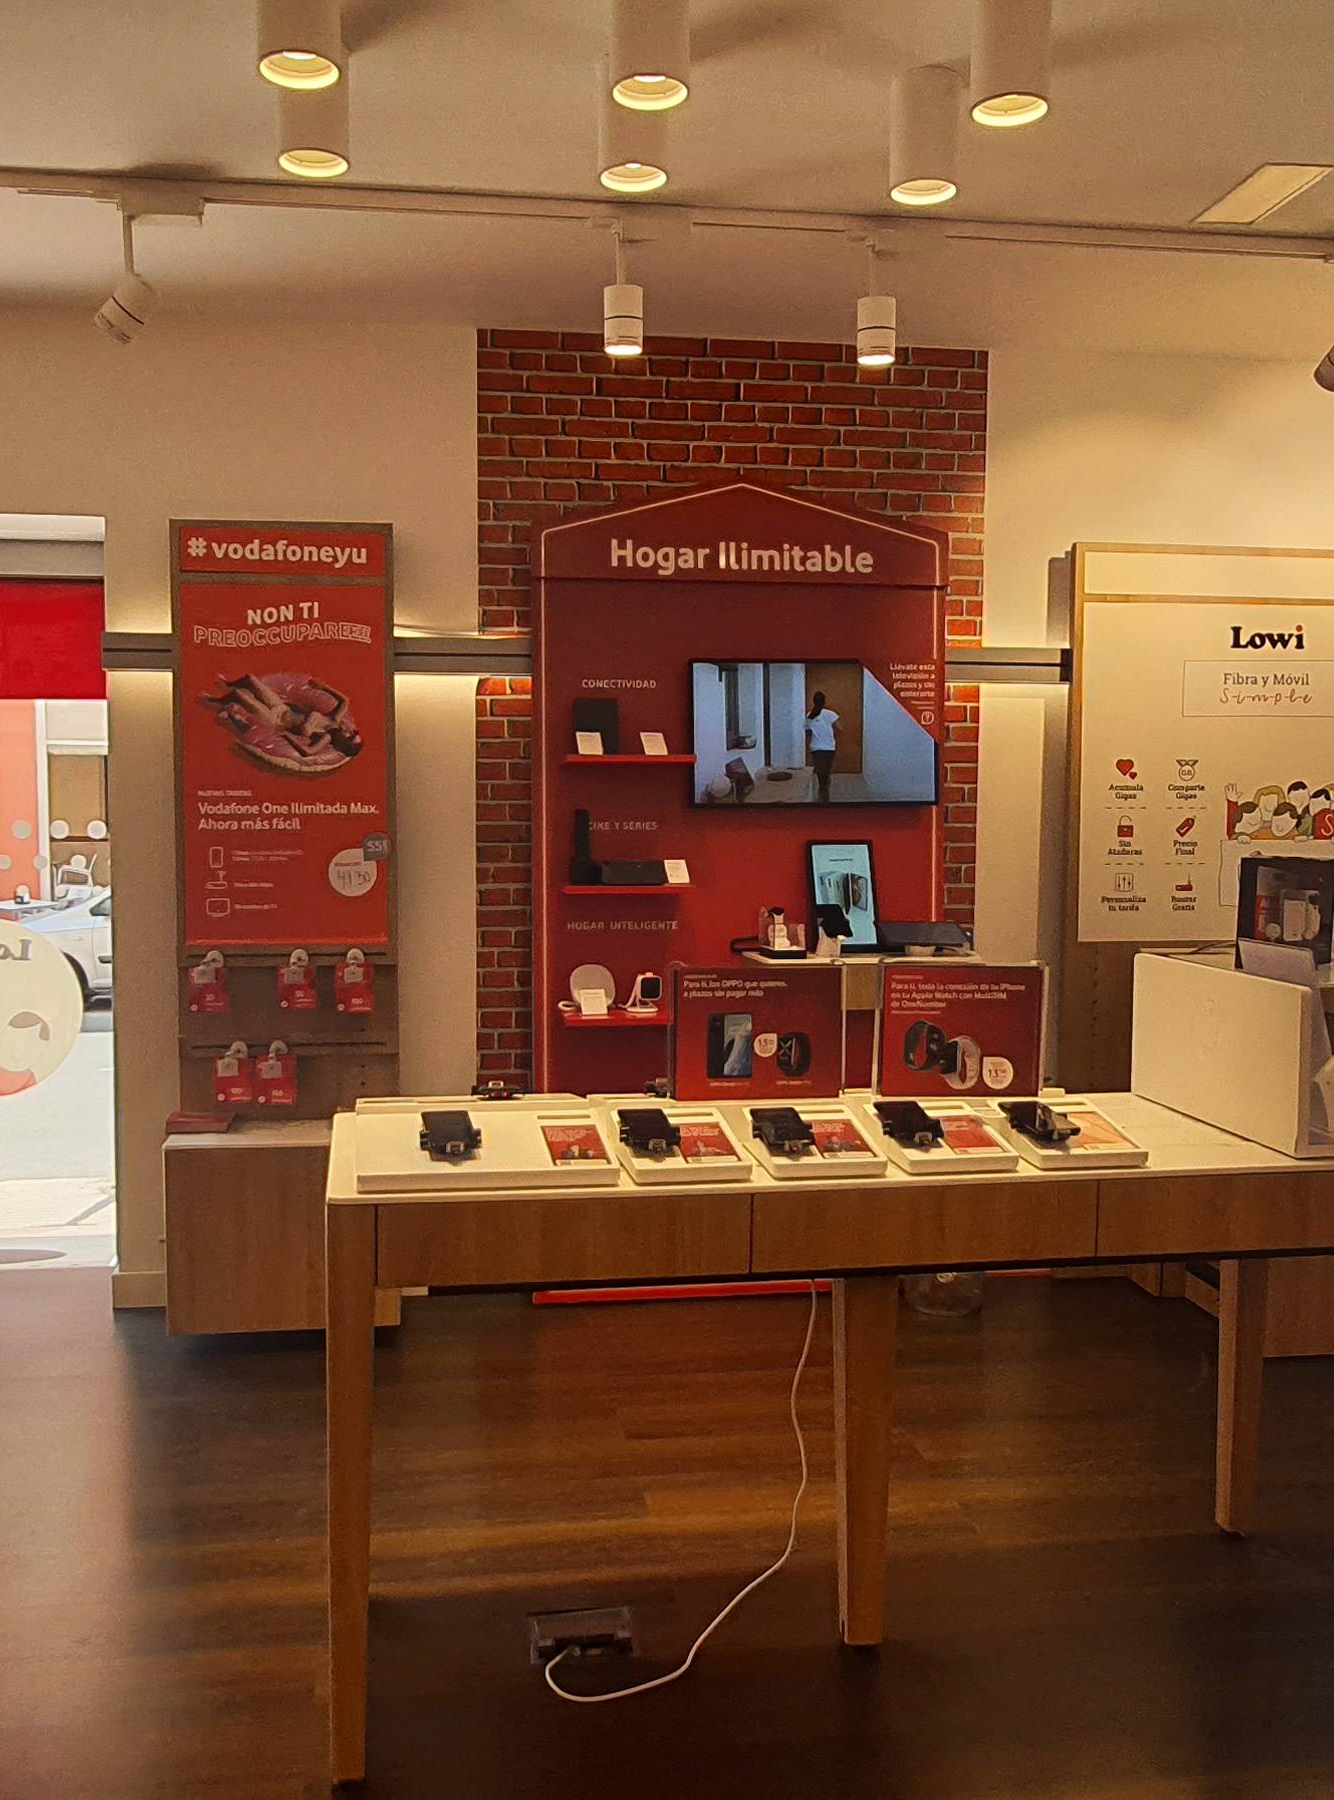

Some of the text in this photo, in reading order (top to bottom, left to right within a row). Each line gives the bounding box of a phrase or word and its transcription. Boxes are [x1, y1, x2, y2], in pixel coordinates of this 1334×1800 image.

[611, 538, 874, 576] Hogar Ilimitable
[247, 601, 319, 625] NON TI
[1230, 624, 1305, 650] Lowi
[582, 679, 657, 689] CONECTIVIDAD
[1223, 672, 1309, 688] Fibra y Móvil
[198, 802, 259, 815] Vodafone
[262, 802, 289, 815] One
[291, 802, 348, 815] Ilimitada
[198, 817, 301, 831] Ahora más fácil
[623, 821, 658, 831] SERIES
[567, 920, 679, 931] HOGAR INTELIGENTE
